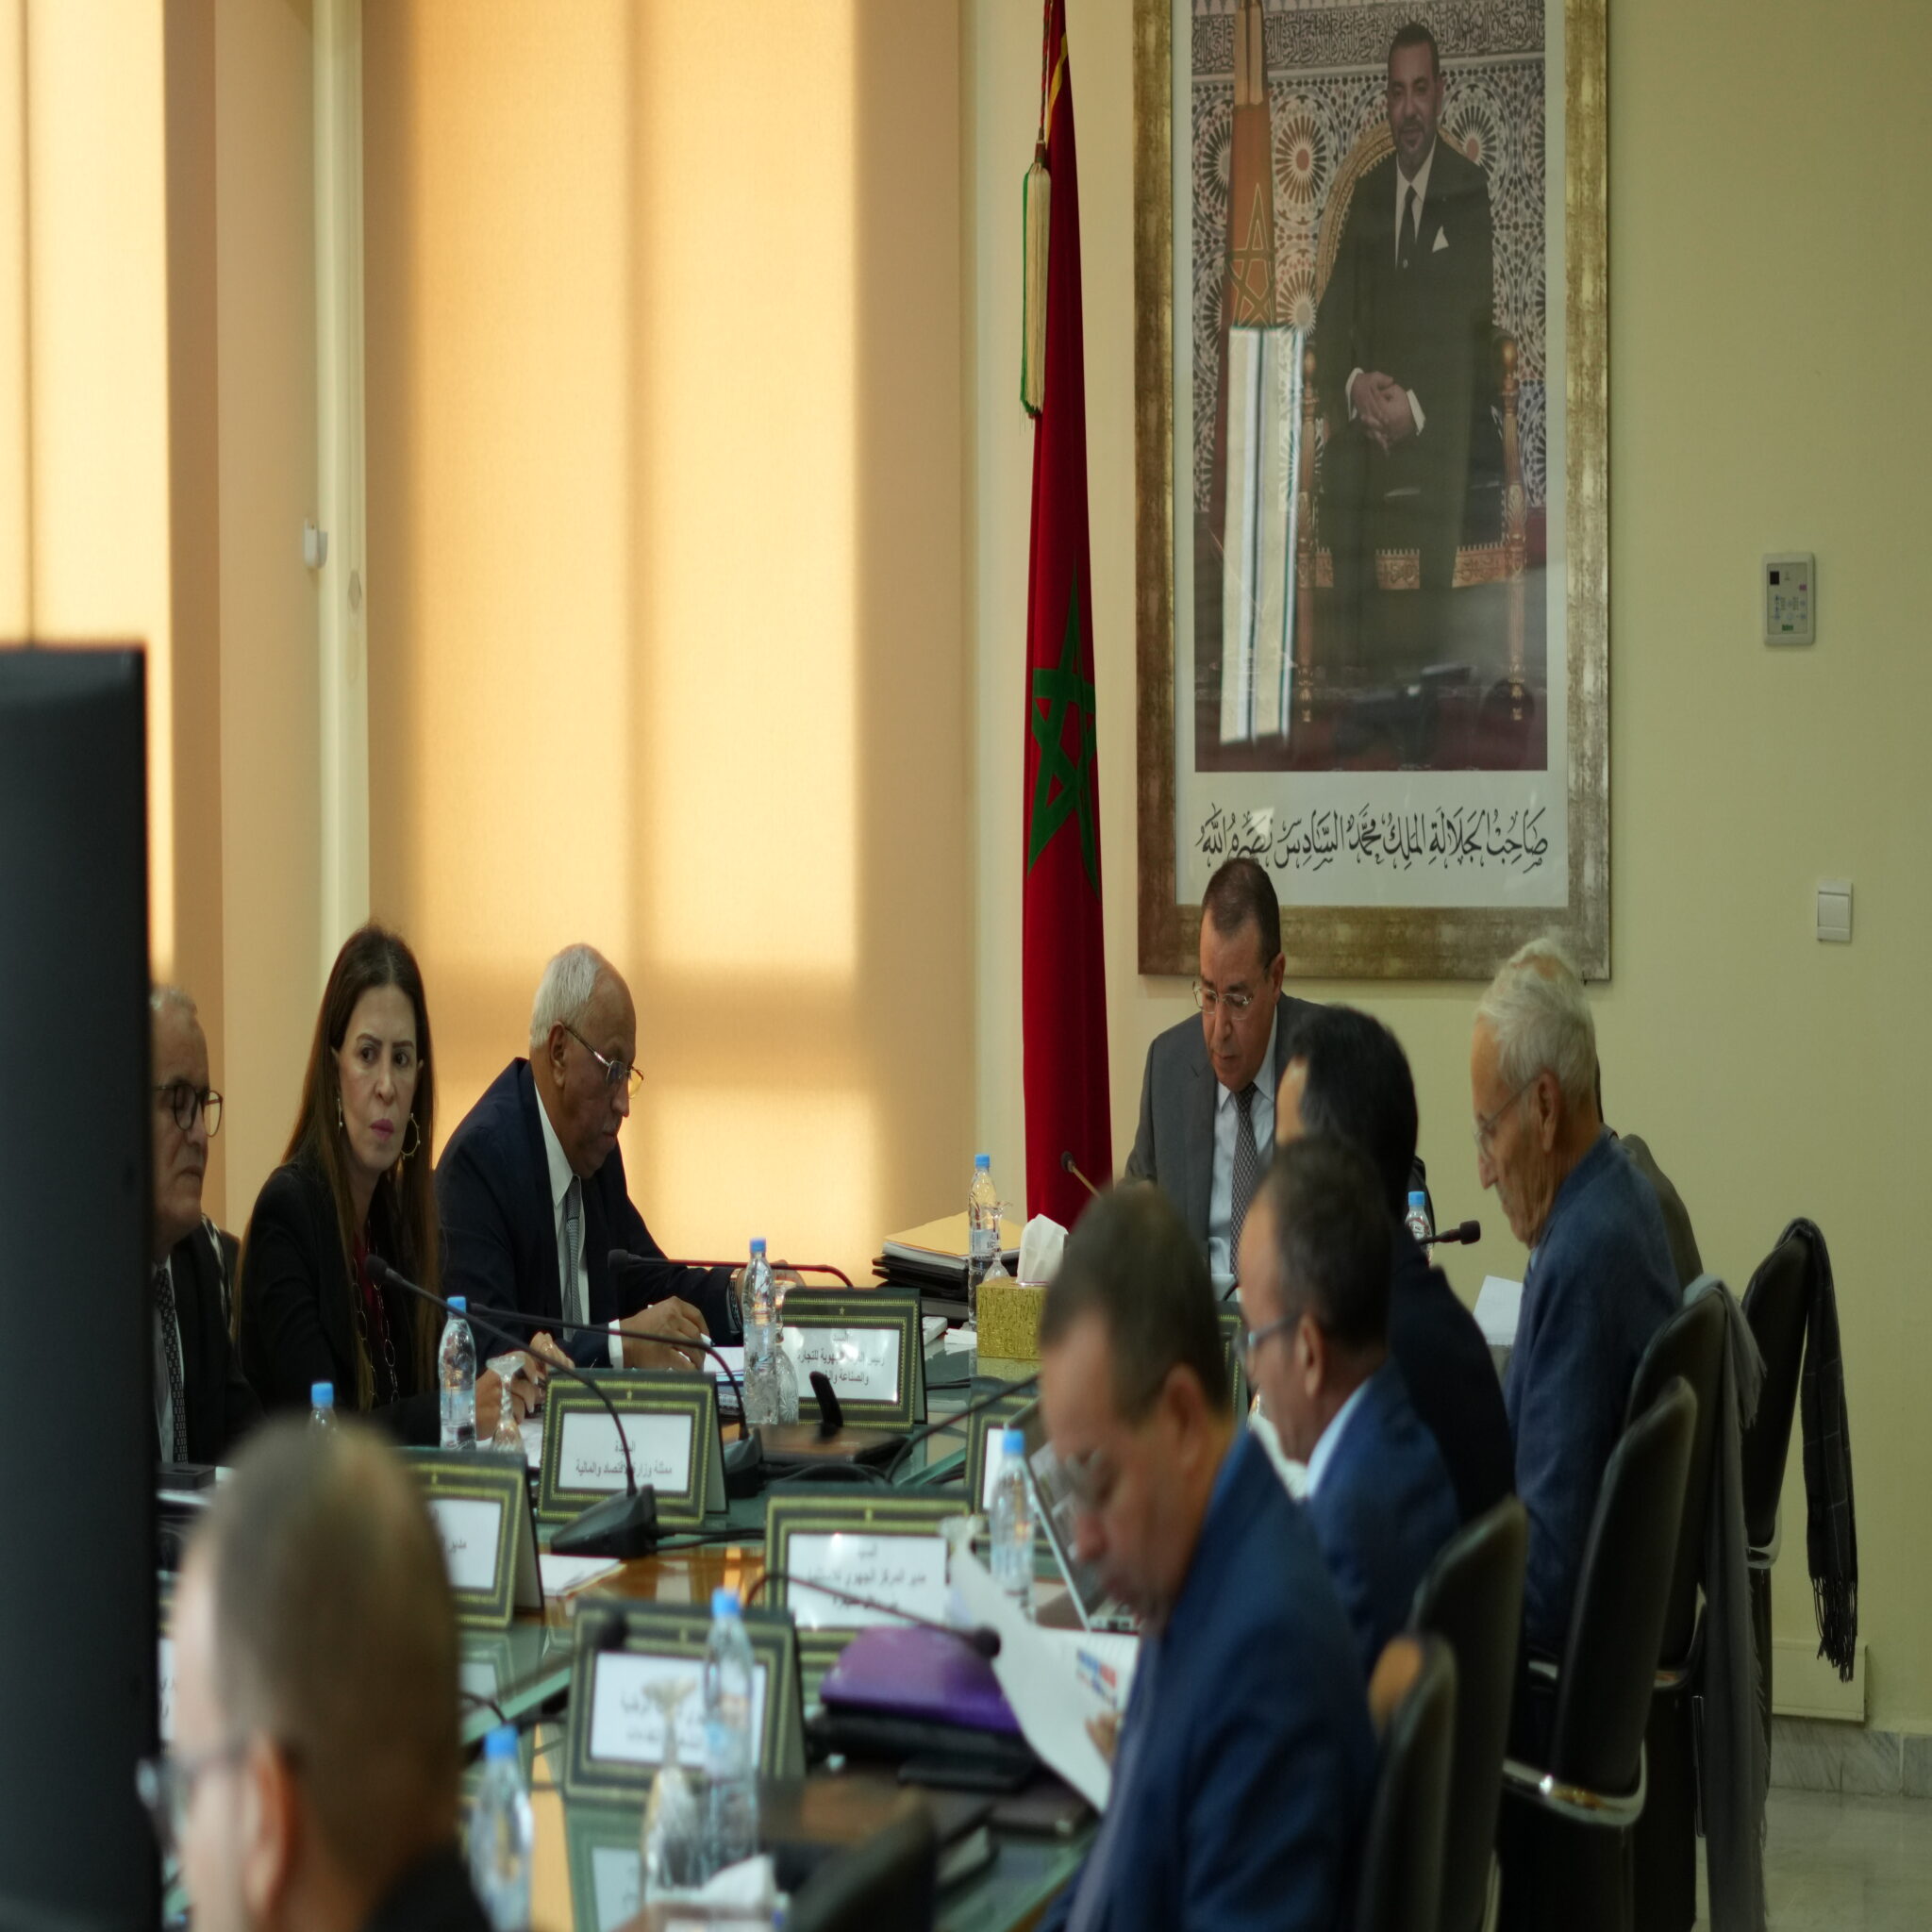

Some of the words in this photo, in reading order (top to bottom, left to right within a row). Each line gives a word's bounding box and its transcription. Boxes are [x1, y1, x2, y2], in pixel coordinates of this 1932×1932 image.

[1195, 802, 1226, 867] الله
[1274, 808, 1344, 871] السادس
[1346, 803, 1383, 866] محمد
[1382, 811, 1426, 870] الملك
[1428, 807, 1491, 870] الجلالة
[1487, 807, 1548, 874] صاحب
[840, 1368, 869, 1385] والصناعة
[615, 1440, 636, 1455] الدة
